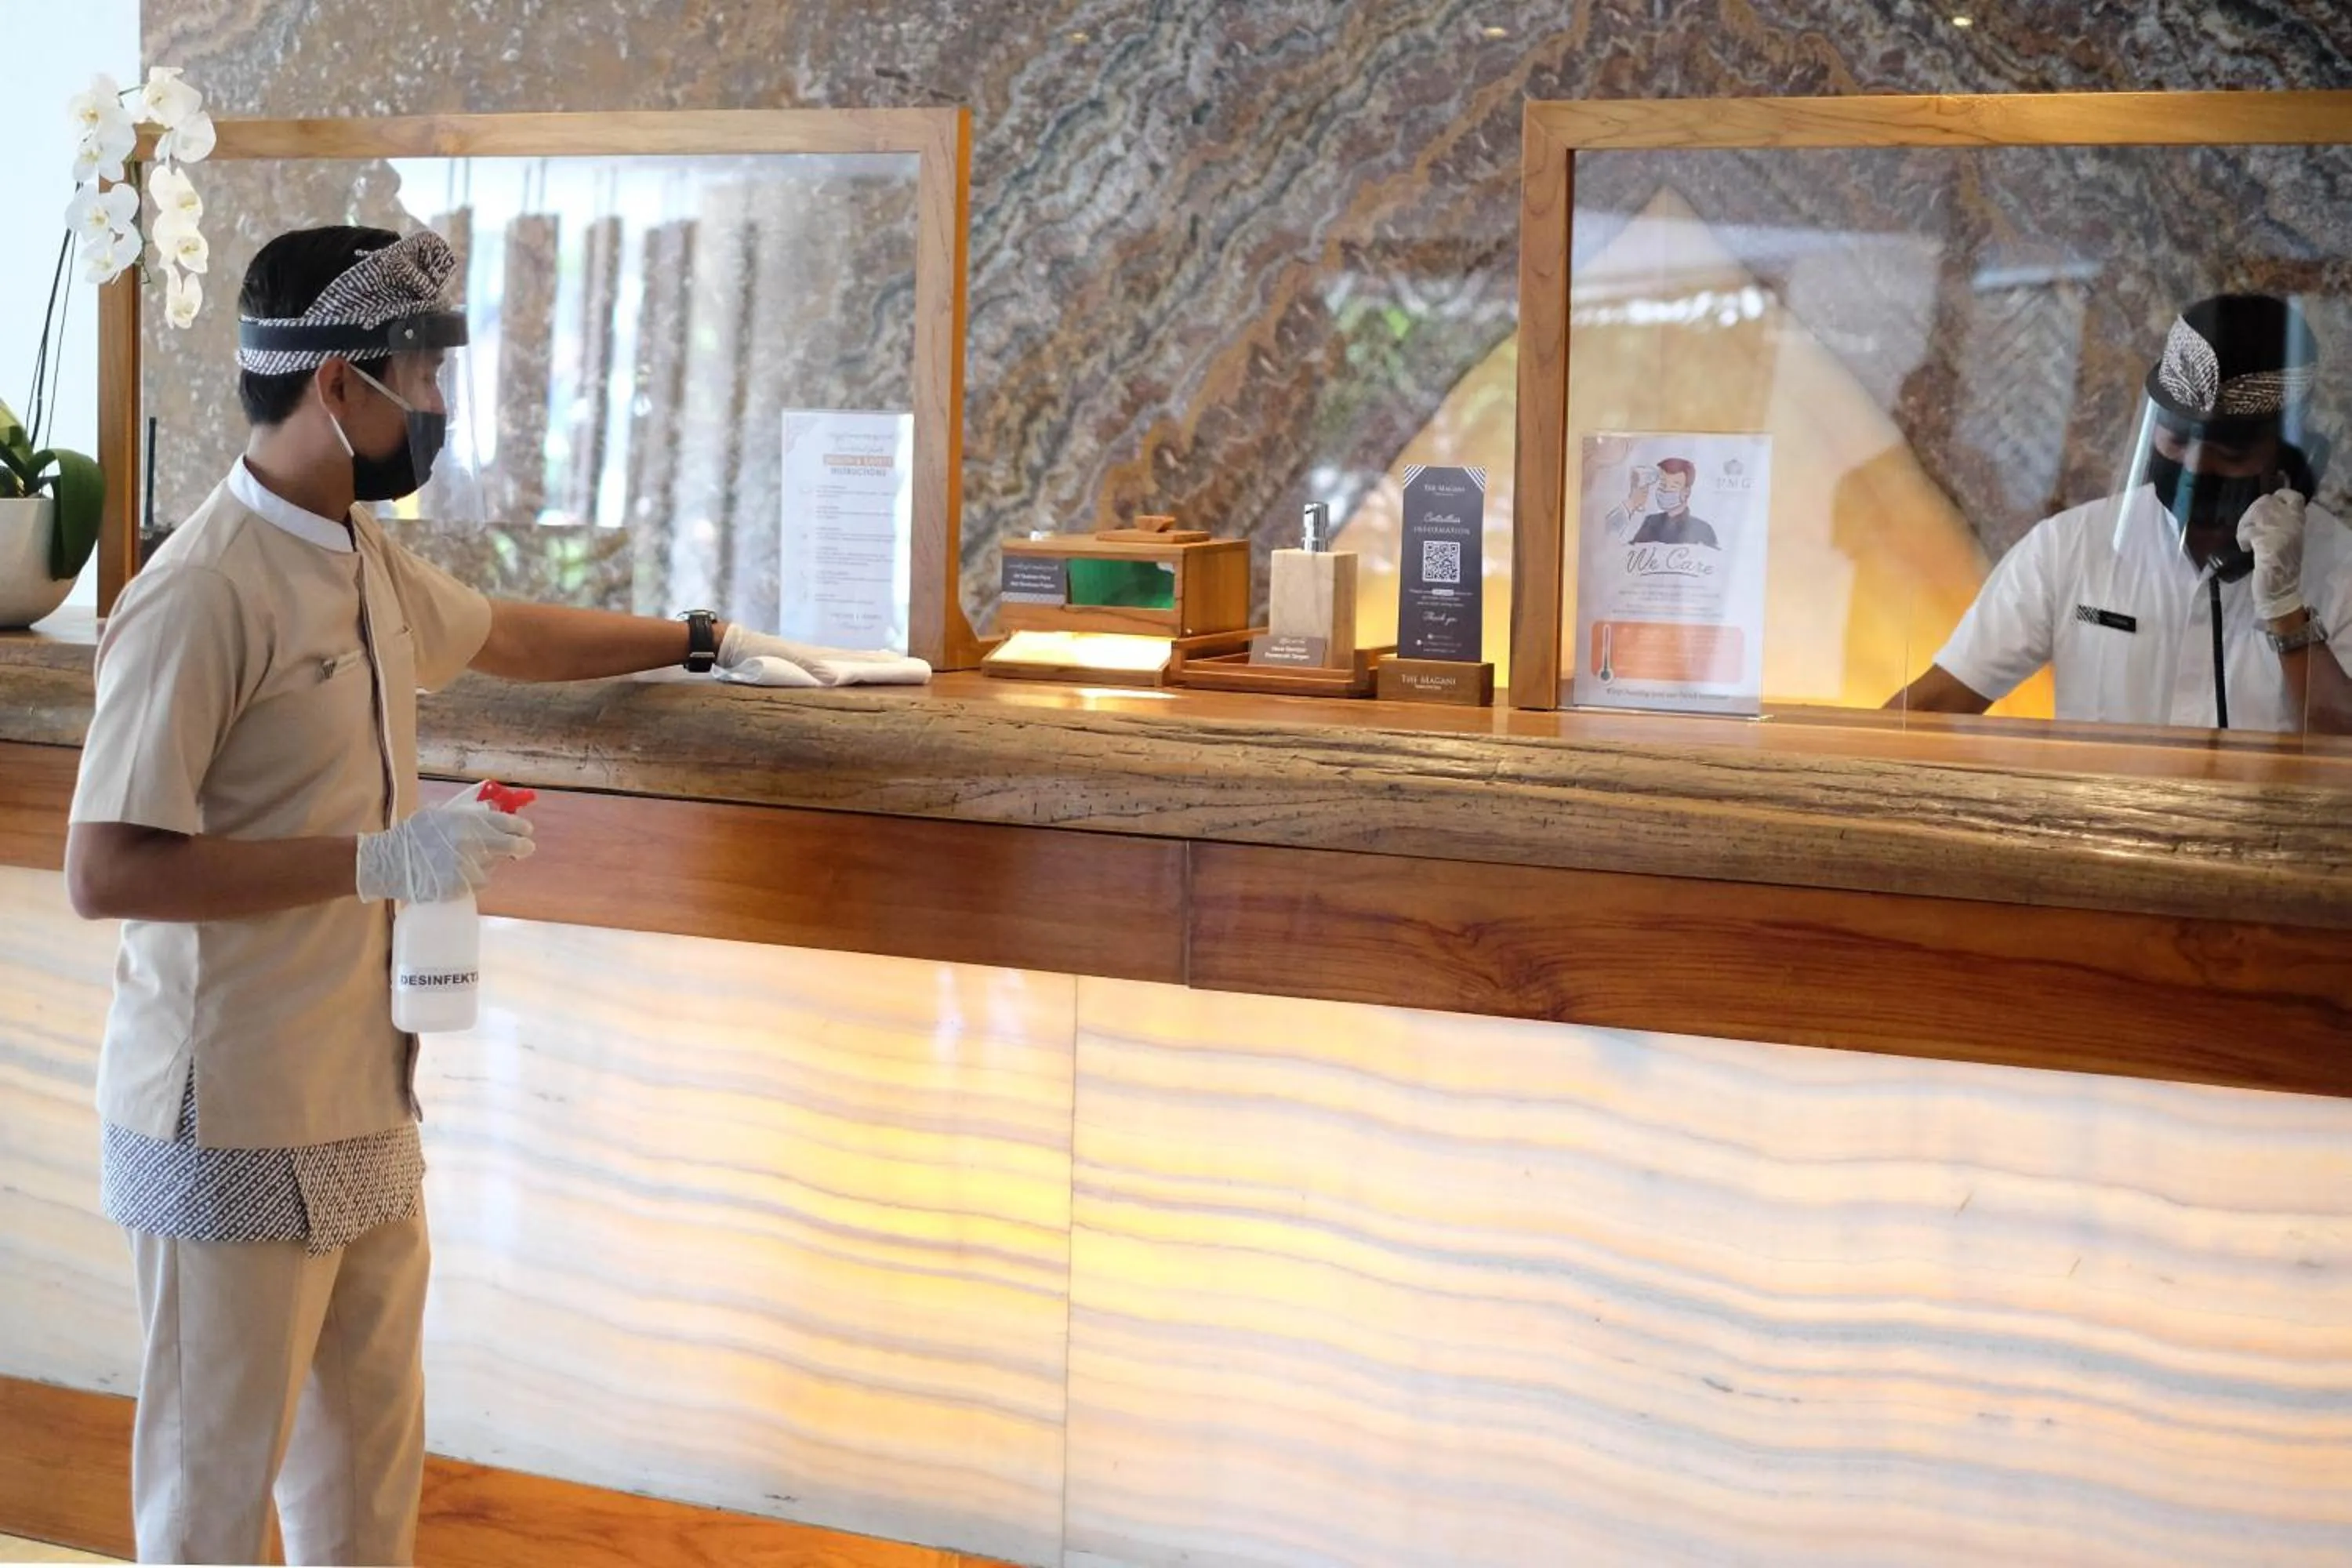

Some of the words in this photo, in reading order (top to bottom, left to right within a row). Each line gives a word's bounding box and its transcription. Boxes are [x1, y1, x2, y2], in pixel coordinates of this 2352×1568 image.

[1626, 546, 1659, 573] We
[1665, 547, 1715, 575] Care
[1420, 675, 1457, 685] MAGANI
